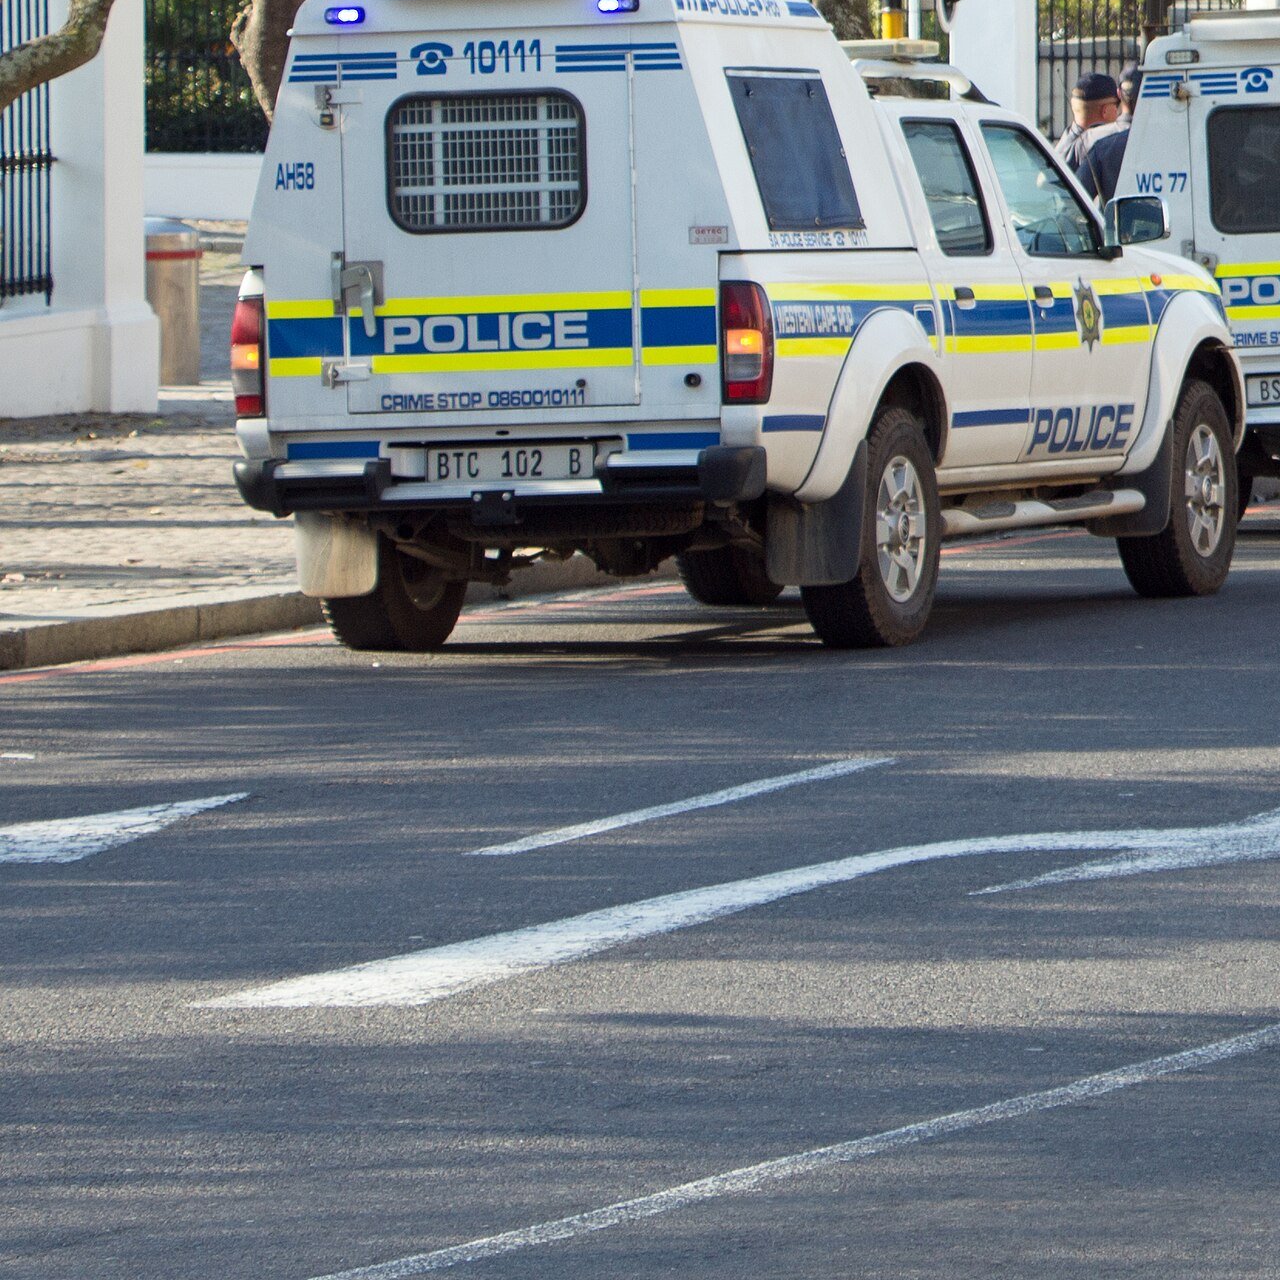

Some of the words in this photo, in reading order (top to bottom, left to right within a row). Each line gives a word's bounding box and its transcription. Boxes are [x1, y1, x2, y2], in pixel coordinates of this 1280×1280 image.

[463, 39, 541, 75] 10111
[275, 162, 315, 190] AH58
[1136, 173, 1163, 193] WC
[1168, 173, 1187, 193] 77
[384, 311, 589, 354] POLICE
[776, 305, 815, 335] WESTERN
[815, 305, 837, 334] CAPE
[381, 393, 434, 411] CRIME
[438, 391, 482, 409] STOP
[488, 388, 585, 407] 0860010111
[1026, 404, 1135, 455] POLICE
[437, 451, 479, 480] BTC
[501, 449, 542, 478] 102
[569, 448, 581, 475] B
